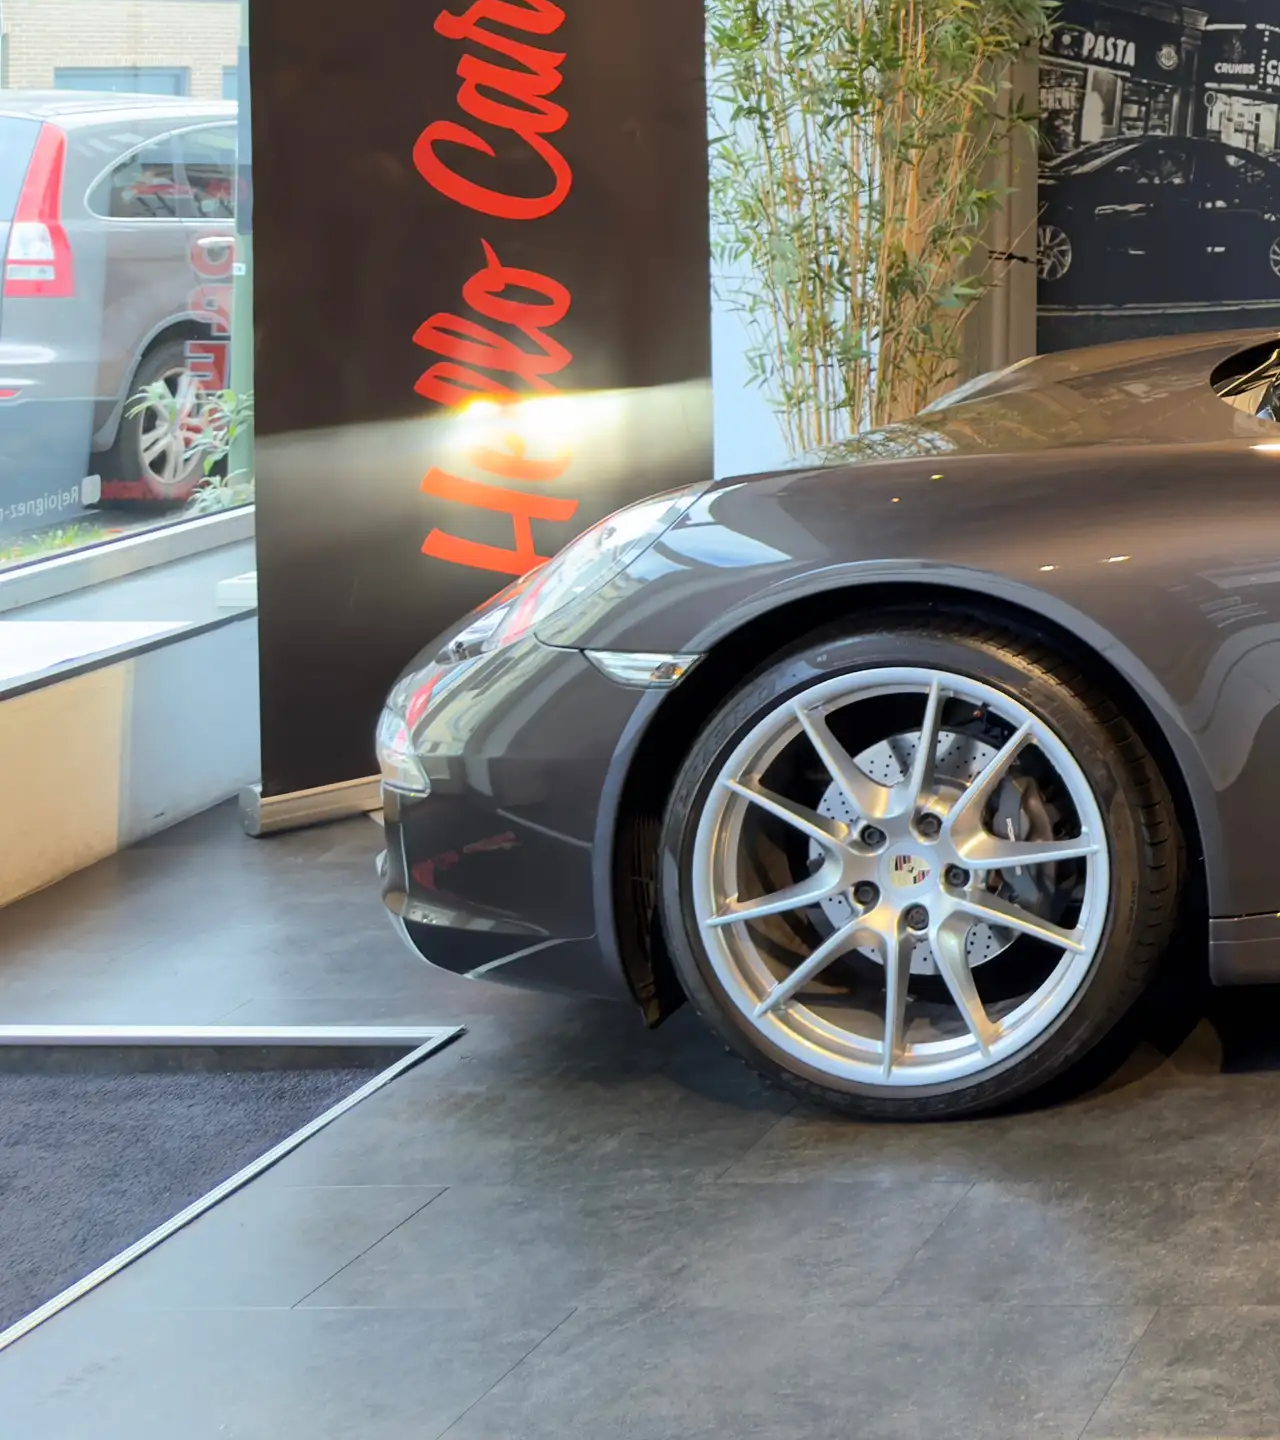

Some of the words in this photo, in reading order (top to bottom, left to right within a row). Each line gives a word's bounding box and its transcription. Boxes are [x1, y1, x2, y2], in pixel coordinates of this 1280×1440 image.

[1082, 31, 1136, 67] PASTA
[1214, 62, 1256, 75] CRUMBS
[413, 237, 579, 576] Hello
